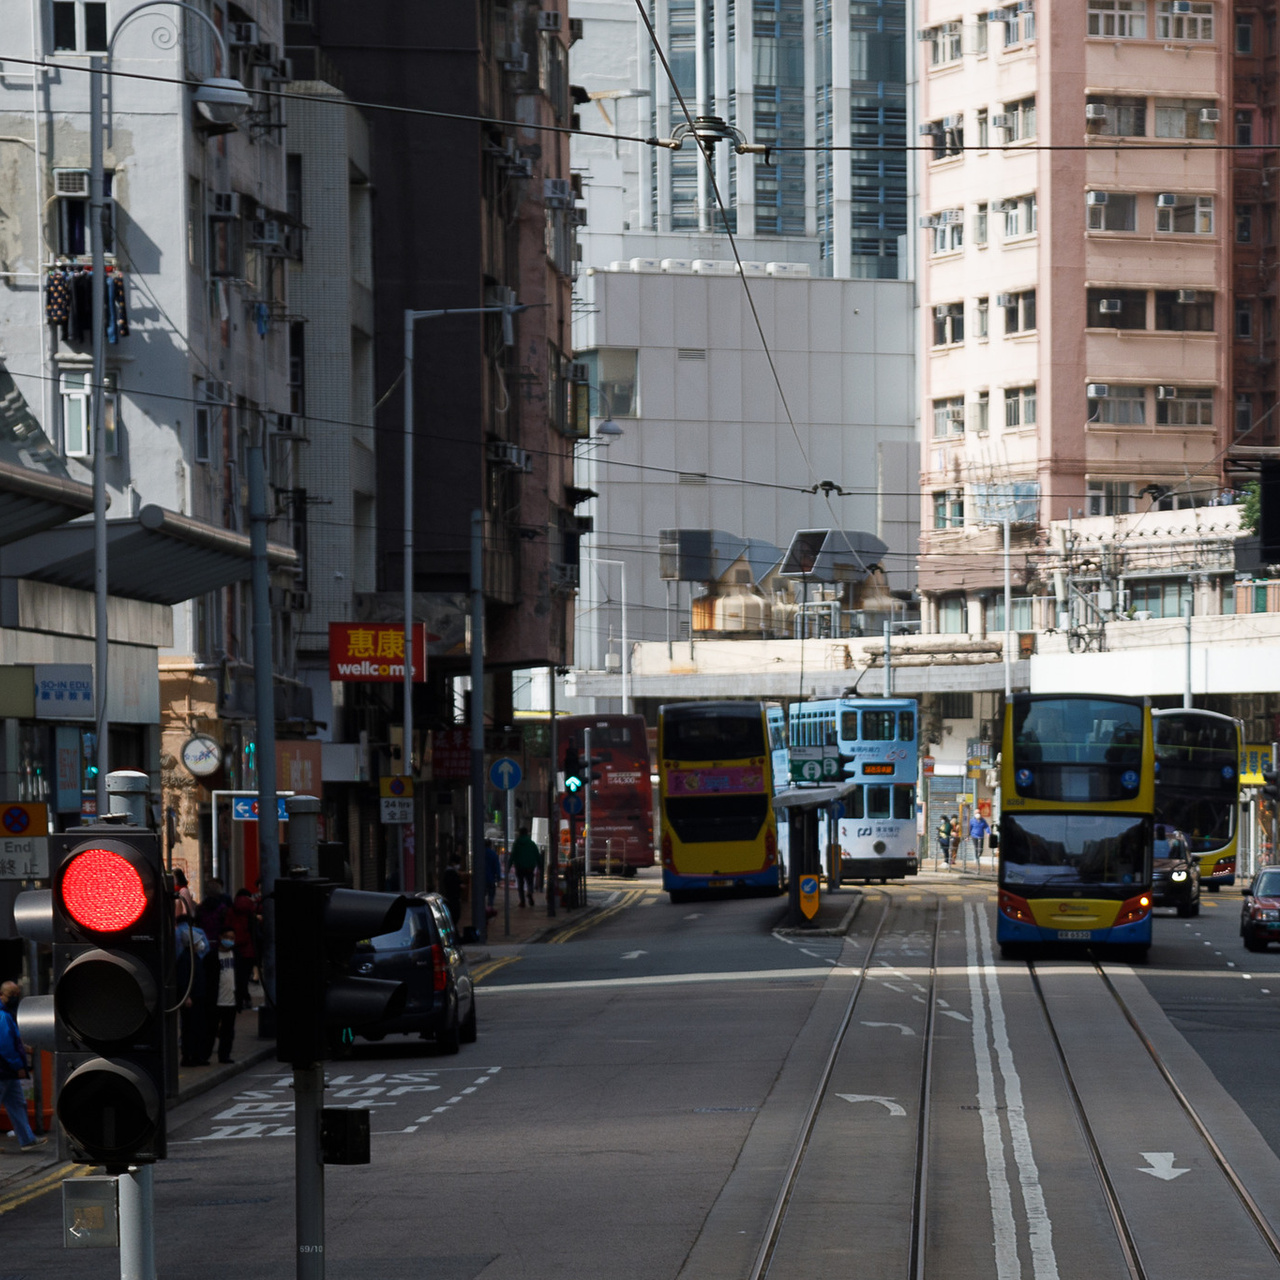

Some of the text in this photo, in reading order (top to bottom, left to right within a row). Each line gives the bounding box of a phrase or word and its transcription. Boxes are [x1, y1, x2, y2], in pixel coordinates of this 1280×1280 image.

[347, 628, 405, 658] 惠康
[384, 801, 411, 809] 24 hrs
[388, 811, 408, 821] 全日
[5, 841, 32, 853] End
[0, 860, 39, 876] 終止
[232, 1085, 441, 1100] SOP
[300, 1245, 323, 1253] 69/10
